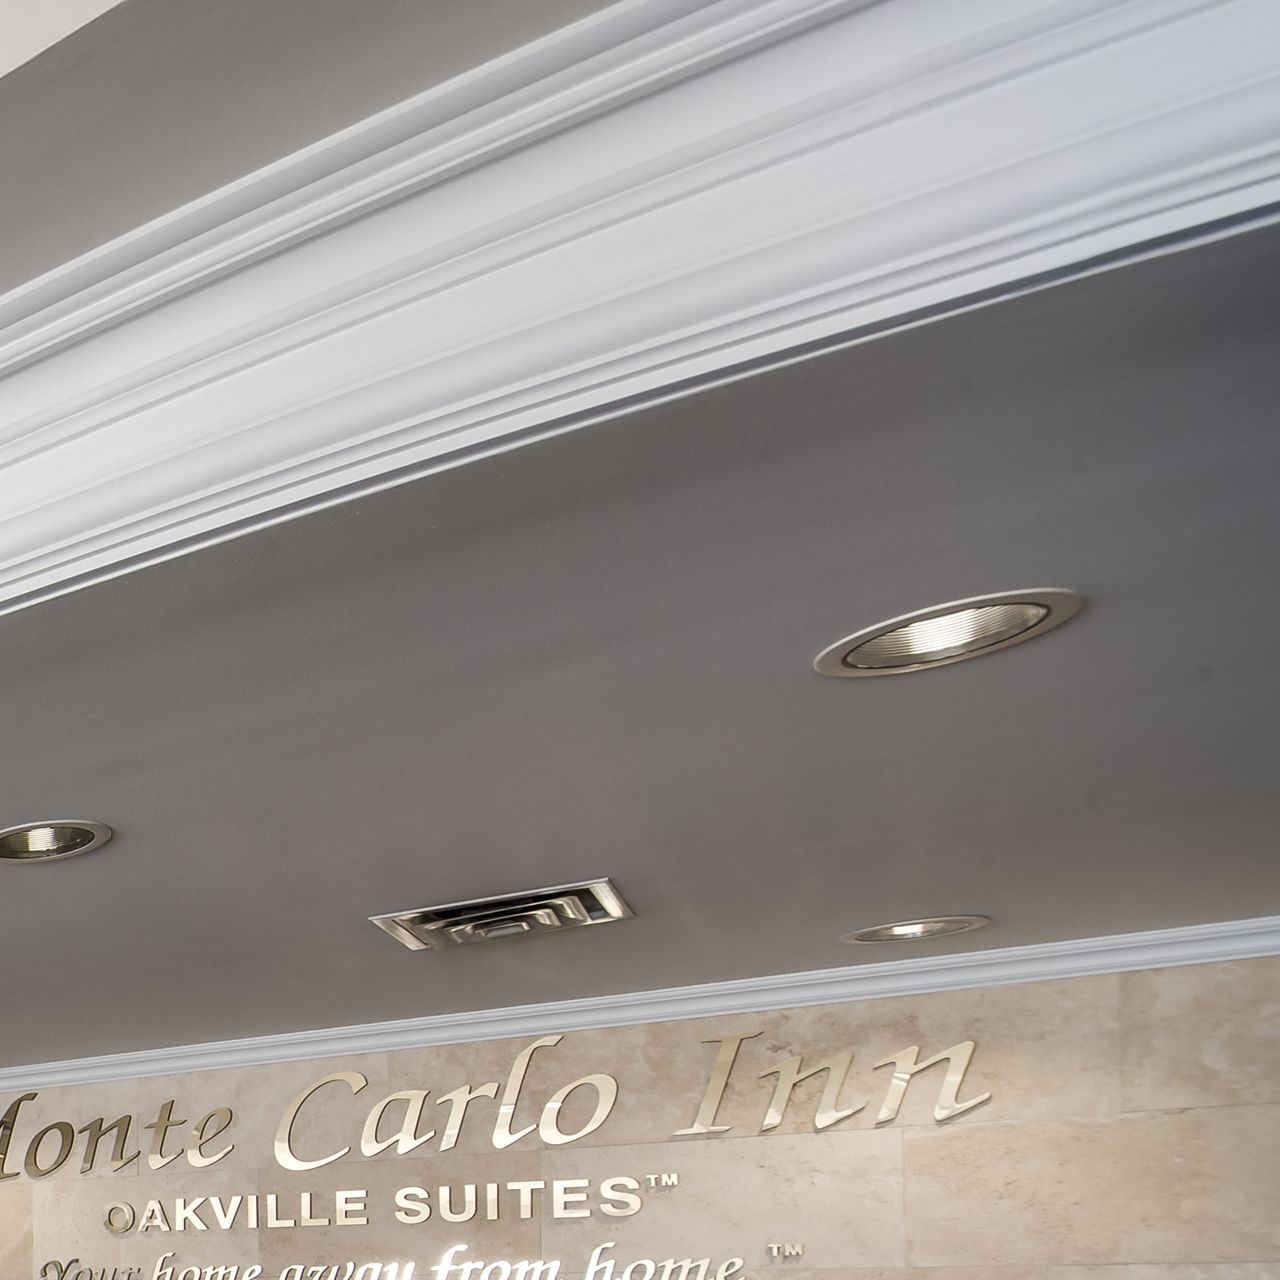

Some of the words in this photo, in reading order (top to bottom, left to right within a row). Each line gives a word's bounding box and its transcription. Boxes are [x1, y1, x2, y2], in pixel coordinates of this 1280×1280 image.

[274, 1035, 619, 1171] Carlo
[672, 1031, 992, 1136] Inn
[105, 1190, 368, 1234] OAKVILLE
